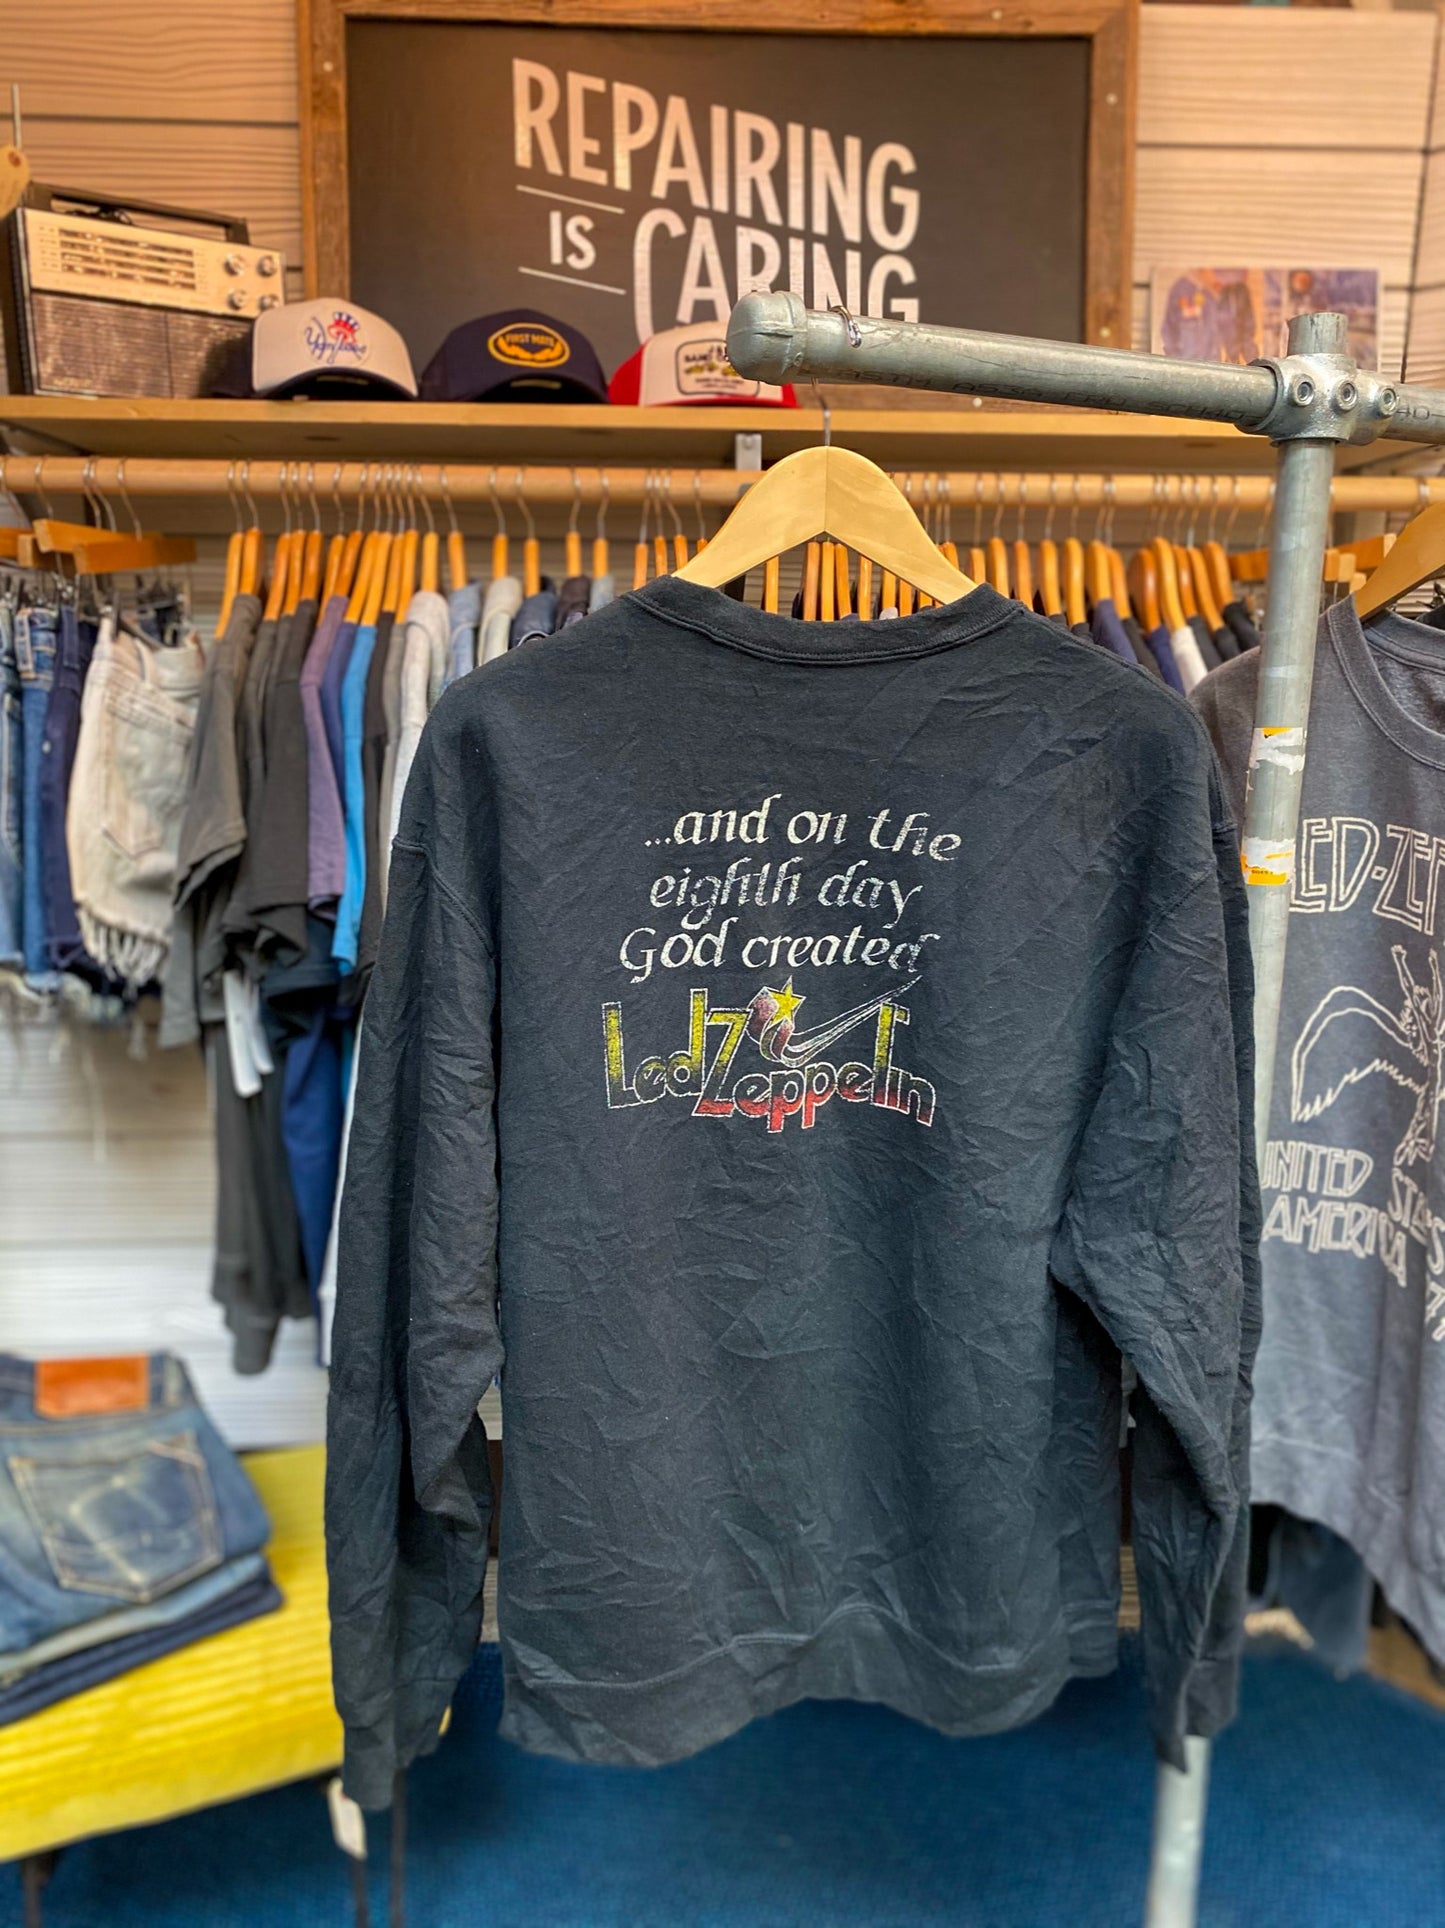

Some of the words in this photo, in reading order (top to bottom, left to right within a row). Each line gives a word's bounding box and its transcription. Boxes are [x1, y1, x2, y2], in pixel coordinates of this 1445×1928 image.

[513, 58, 920, 251] REPAIRING
[550, 211, 596, 269] IS
[505, 333, 530, 344] FIRST
[531, 333, 555, 347] MATE
[787, 811, 848, 845] on
[867, 808, 962, 862] the
[649, 857, 803, 930] eighth
[817, 859, 923, 929] day
[619, 917, 739, 984] God
[741, 925, 941, 973] created
